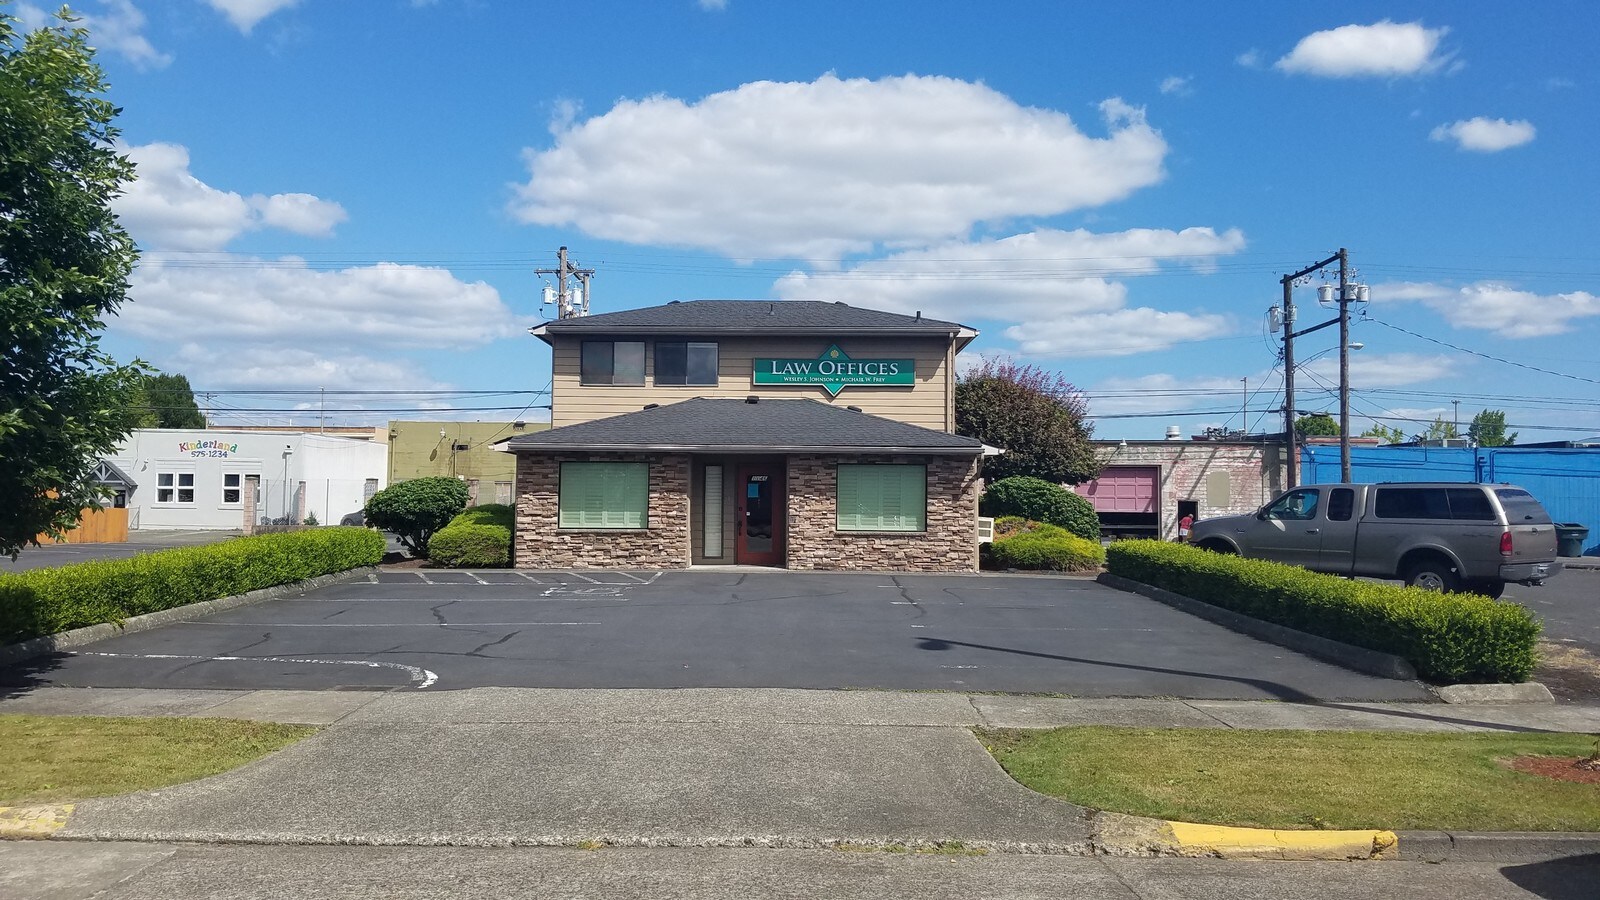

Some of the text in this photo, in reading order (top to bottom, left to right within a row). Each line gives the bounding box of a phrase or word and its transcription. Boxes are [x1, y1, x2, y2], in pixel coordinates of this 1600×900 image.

[771, 360, 899, 376] LAW OFFICES
[179, 440, 238, 453] Kinderland
[191, 451, 228, 459] 575-1234
